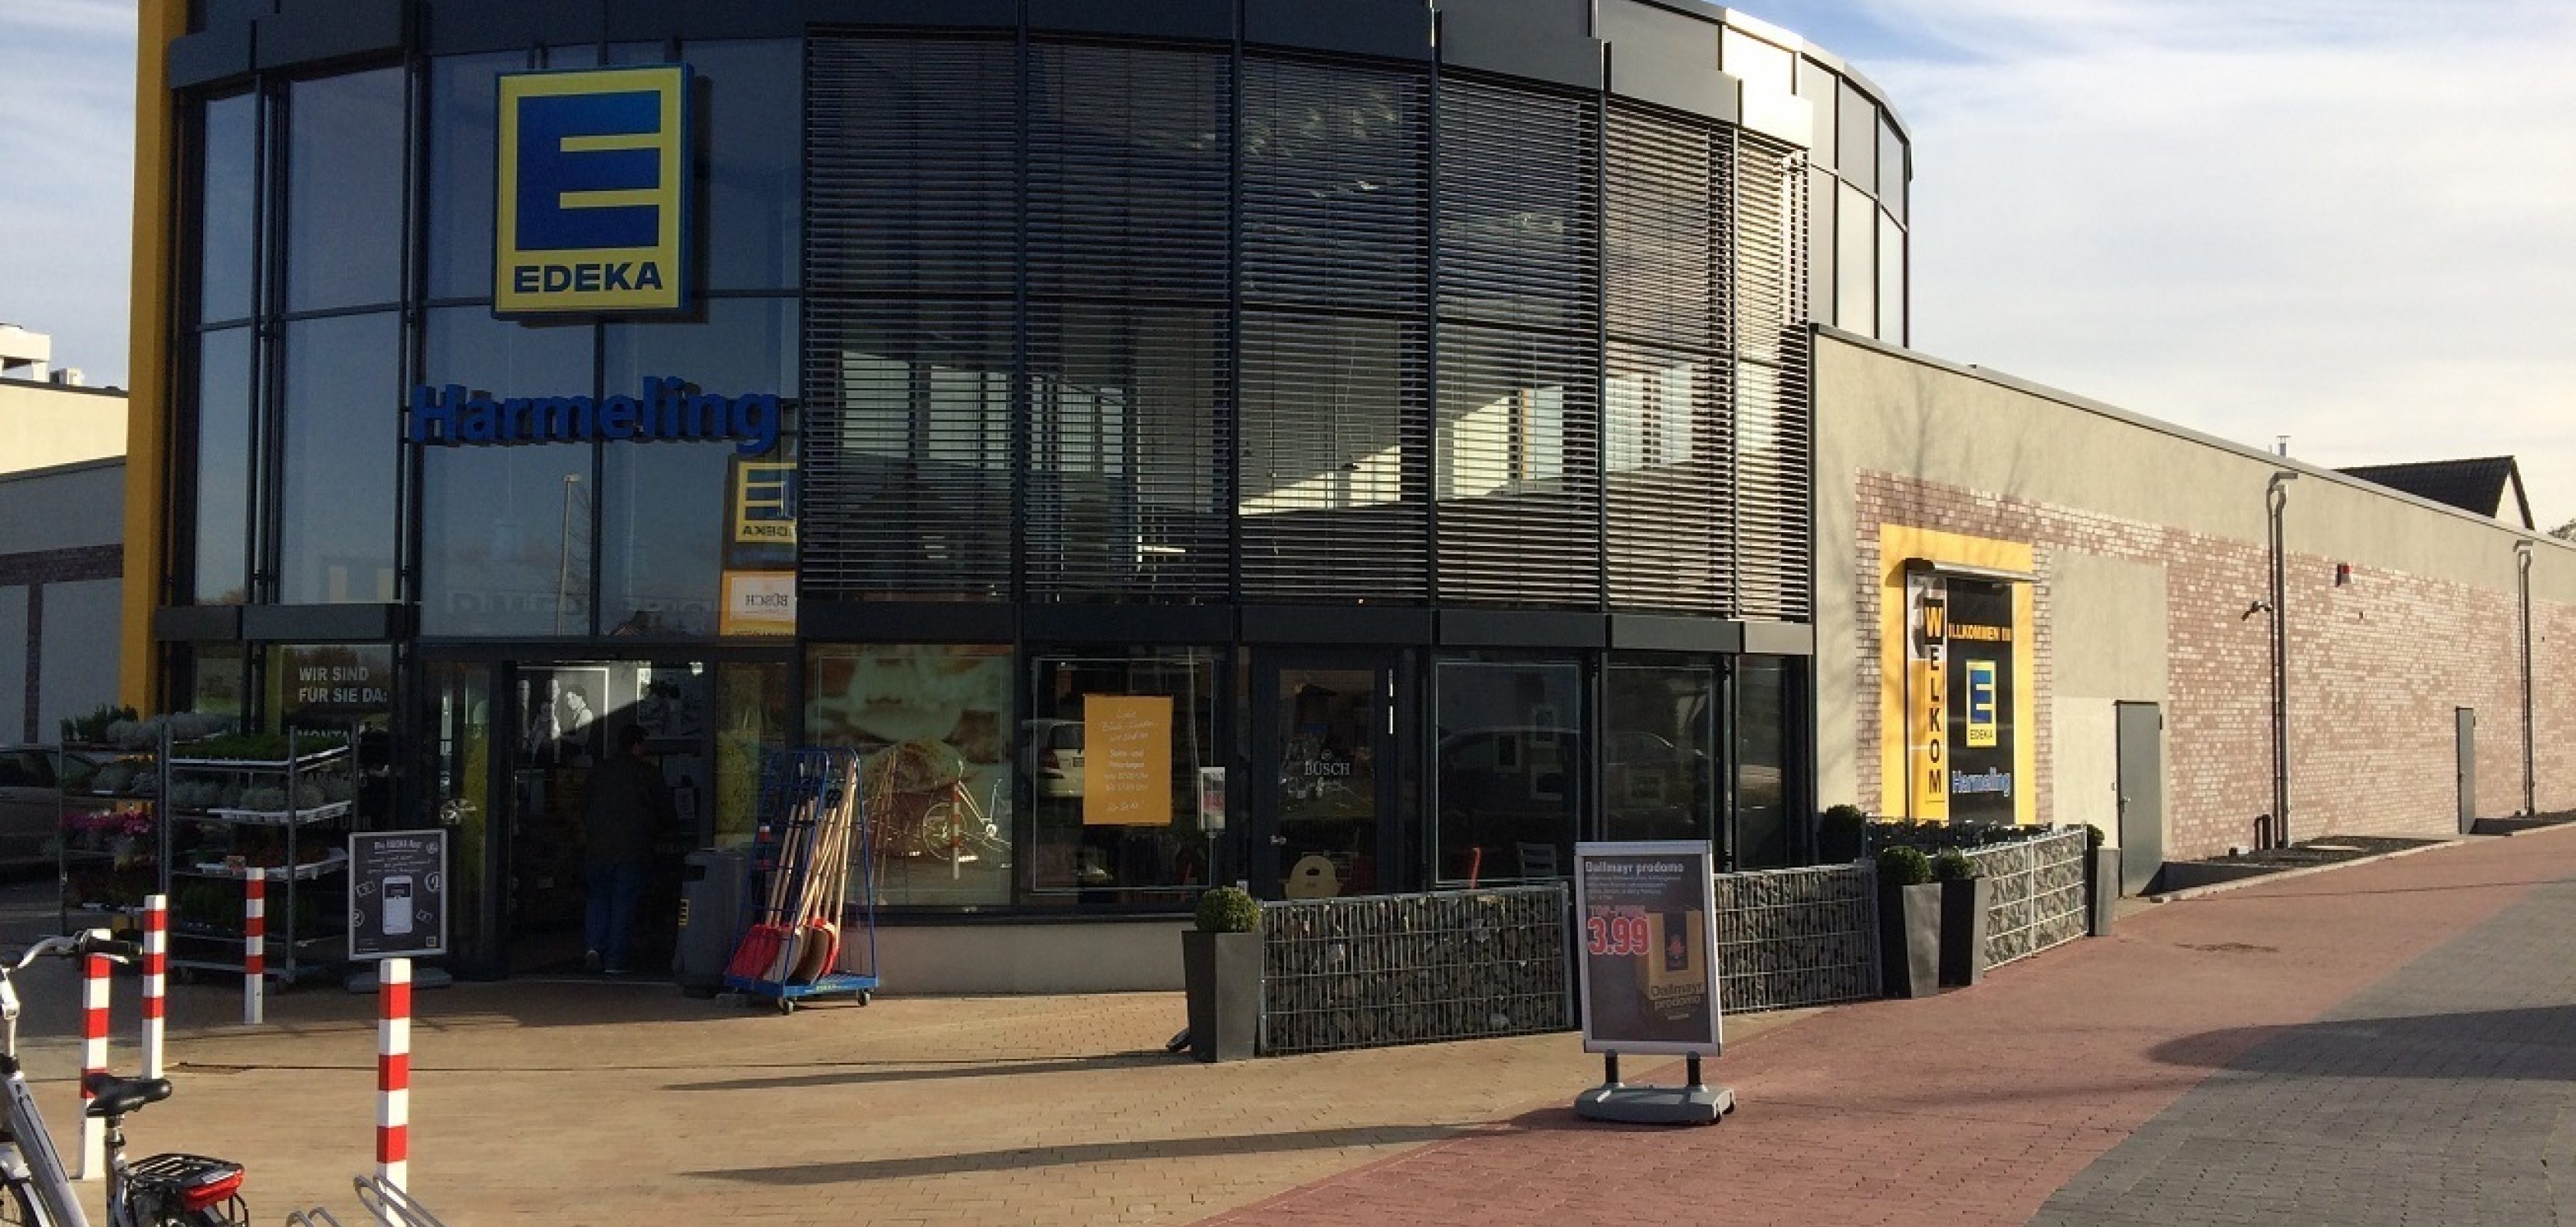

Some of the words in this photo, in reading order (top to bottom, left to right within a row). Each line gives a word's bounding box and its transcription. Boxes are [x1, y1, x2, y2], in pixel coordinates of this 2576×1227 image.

[514, 262, 663, 294] EDEKA
[409, 376, 780, 454] Harmeling
[299, 666, 328, 681] WIR
[333, 666, 370, 681] SIND
[299, 686, 328, 702] FÜR
[333, 687, 358, 702] SIE
[362, 687, 387, 702] DA:
[1970, 729, 1993, 740] EDEKA
[1585, 860, 1633, 874] Dallmayr
[1636, 860, 1685, 877] prodomo
[1587, 916, 1651, 956] 3.99
[1651, 982, 1702, 997] Dallmayr
